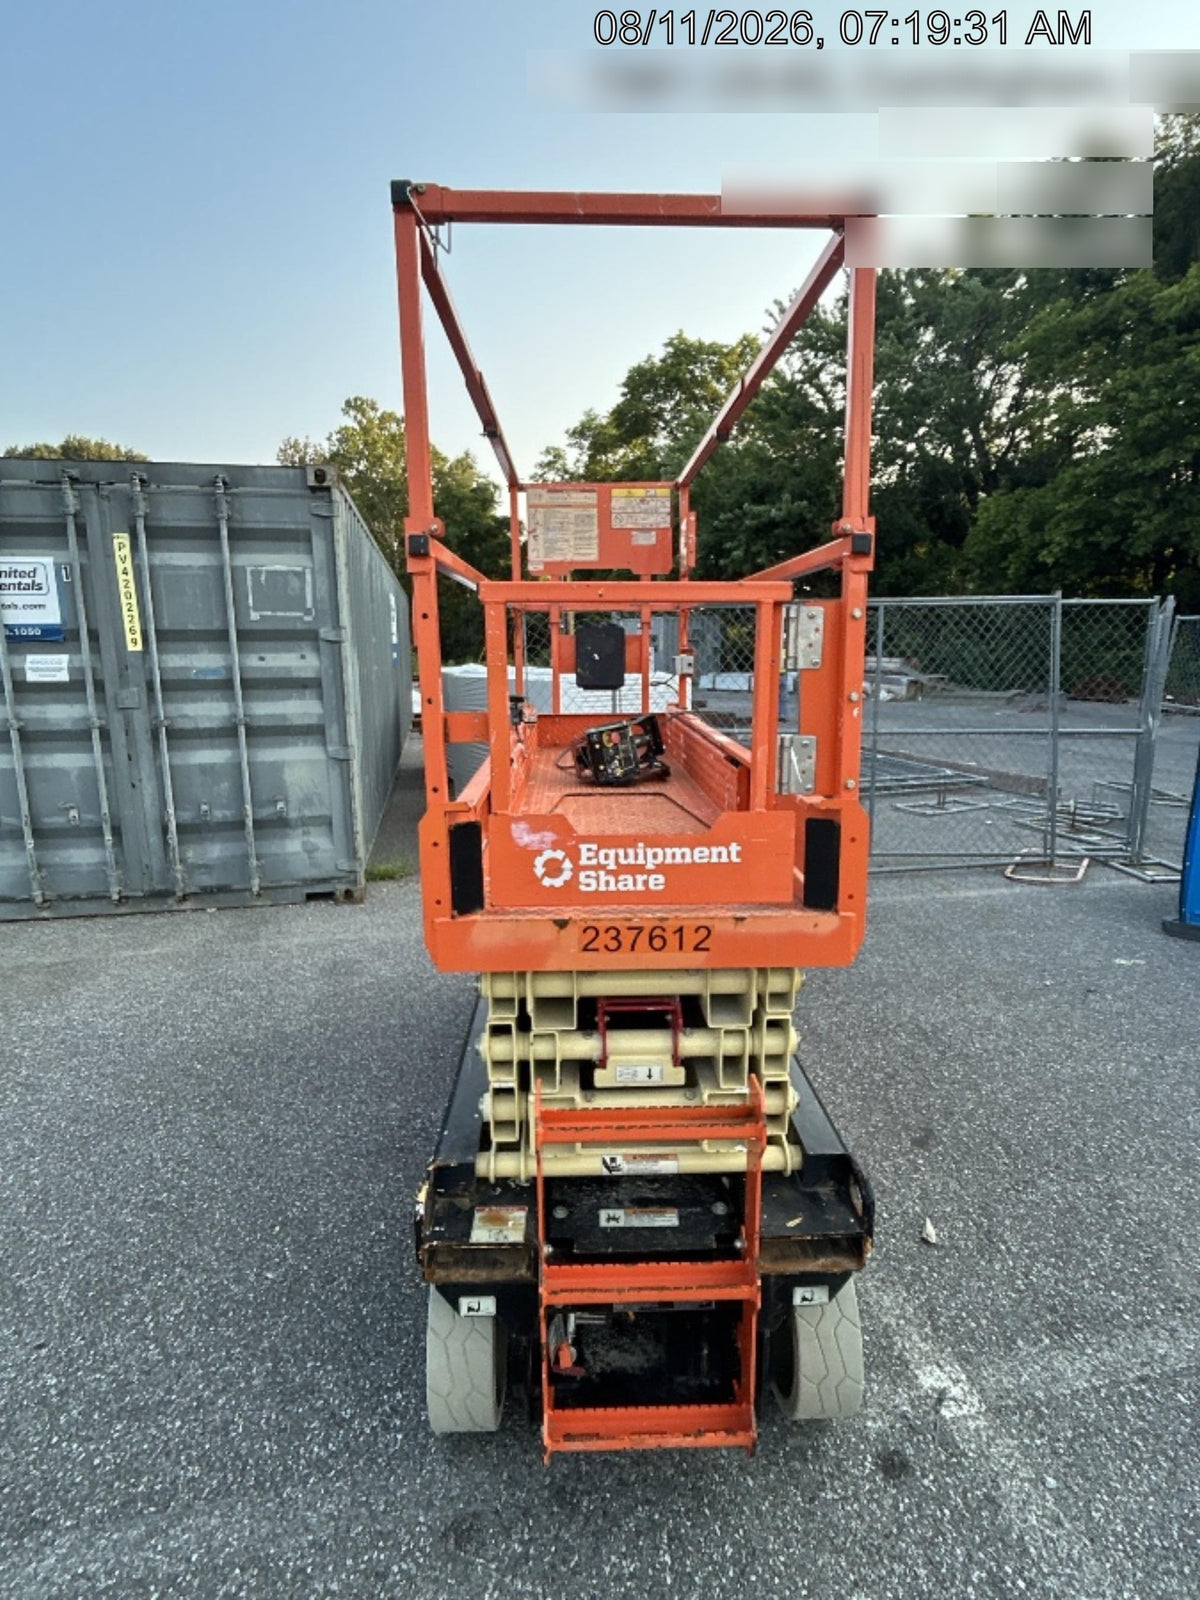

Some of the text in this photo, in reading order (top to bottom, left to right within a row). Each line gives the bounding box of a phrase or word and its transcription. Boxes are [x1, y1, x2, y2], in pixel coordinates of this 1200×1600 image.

[0, 566, 37, 579] nited
[0, 579, 43, 591] entals
[578, 842, 743, 870] Equipment
[578, 870, 666, 892] Share
[581, 925, 712, 952] 237612
